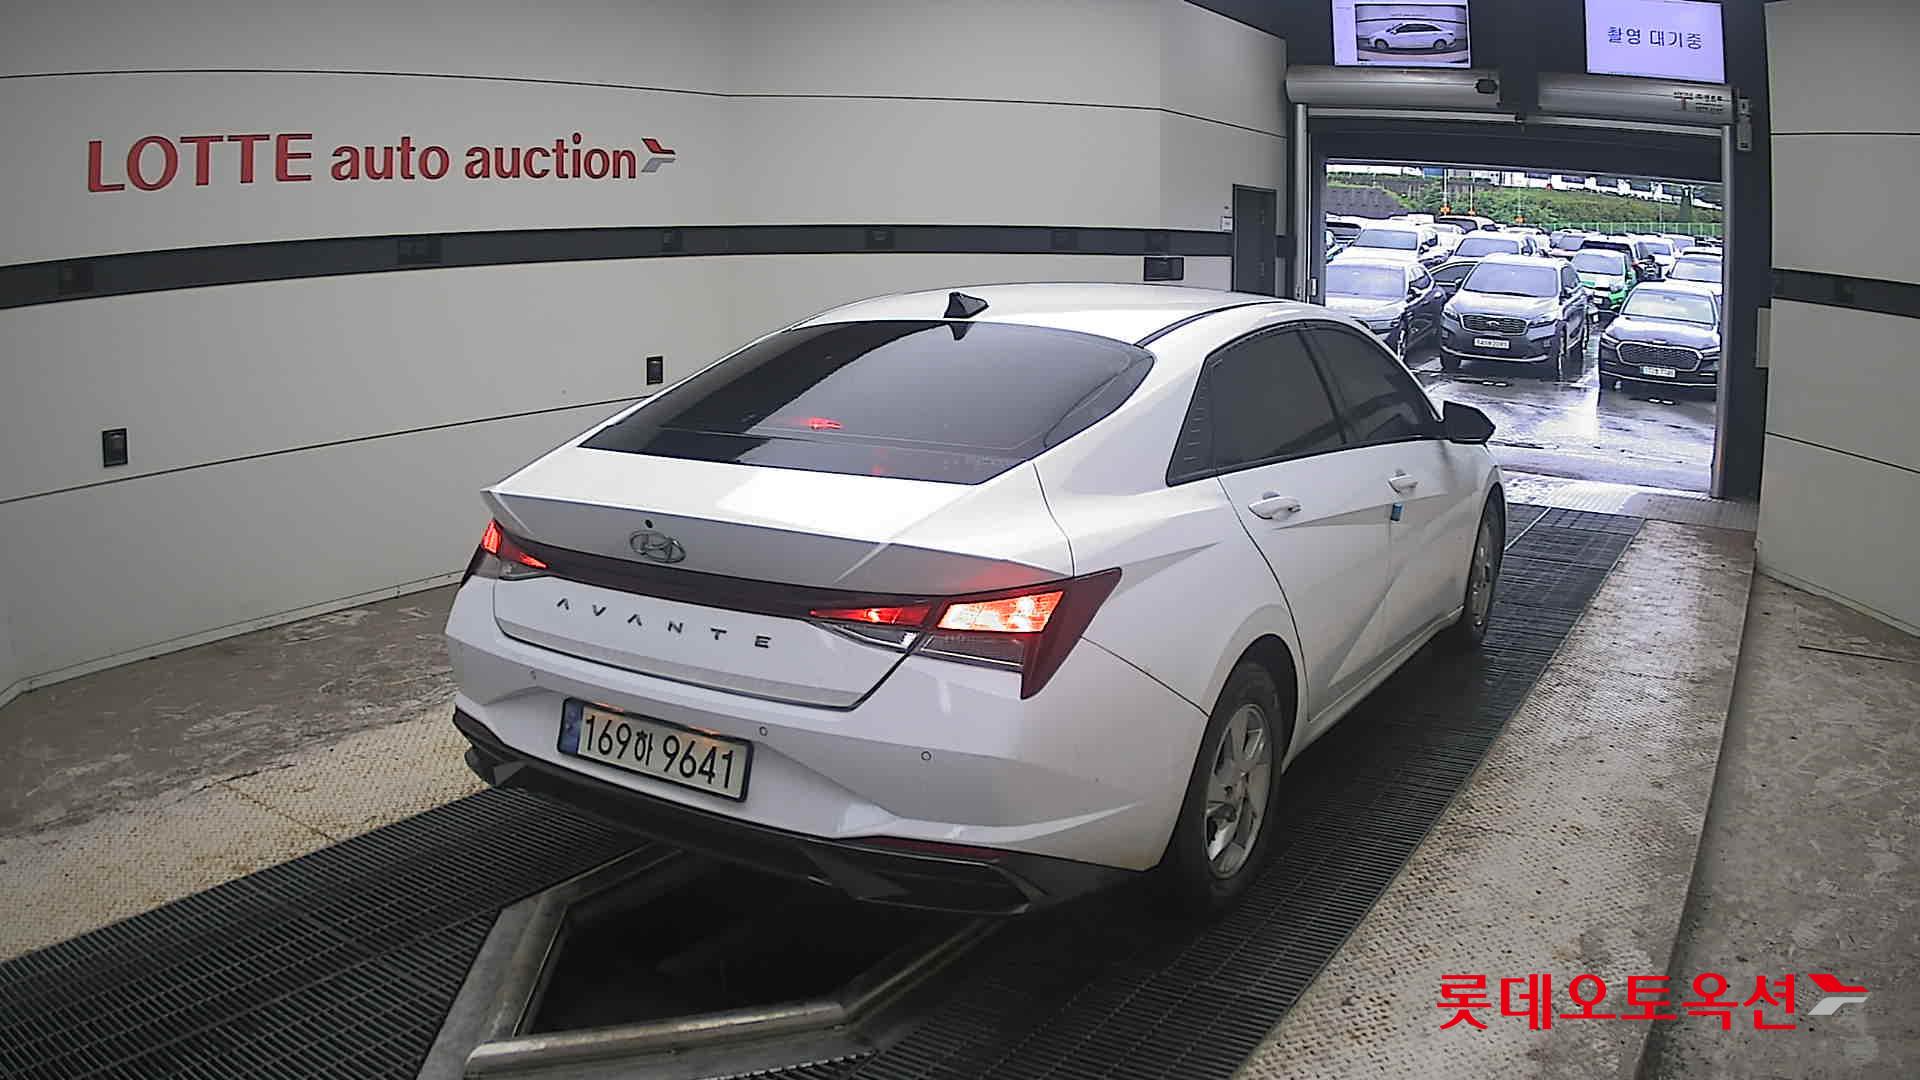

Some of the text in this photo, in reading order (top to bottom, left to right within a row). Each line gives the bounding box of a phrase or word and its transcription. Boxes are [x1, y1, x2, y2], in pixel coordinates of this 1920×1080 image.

[1607, 26, 1702, 50] 촬영 대기중
[87, 132, 638, 193] LOTTE auto auction
[556, 598, 772, 649] AVANTE
[585, 714, 736, 789] 169하 9641
